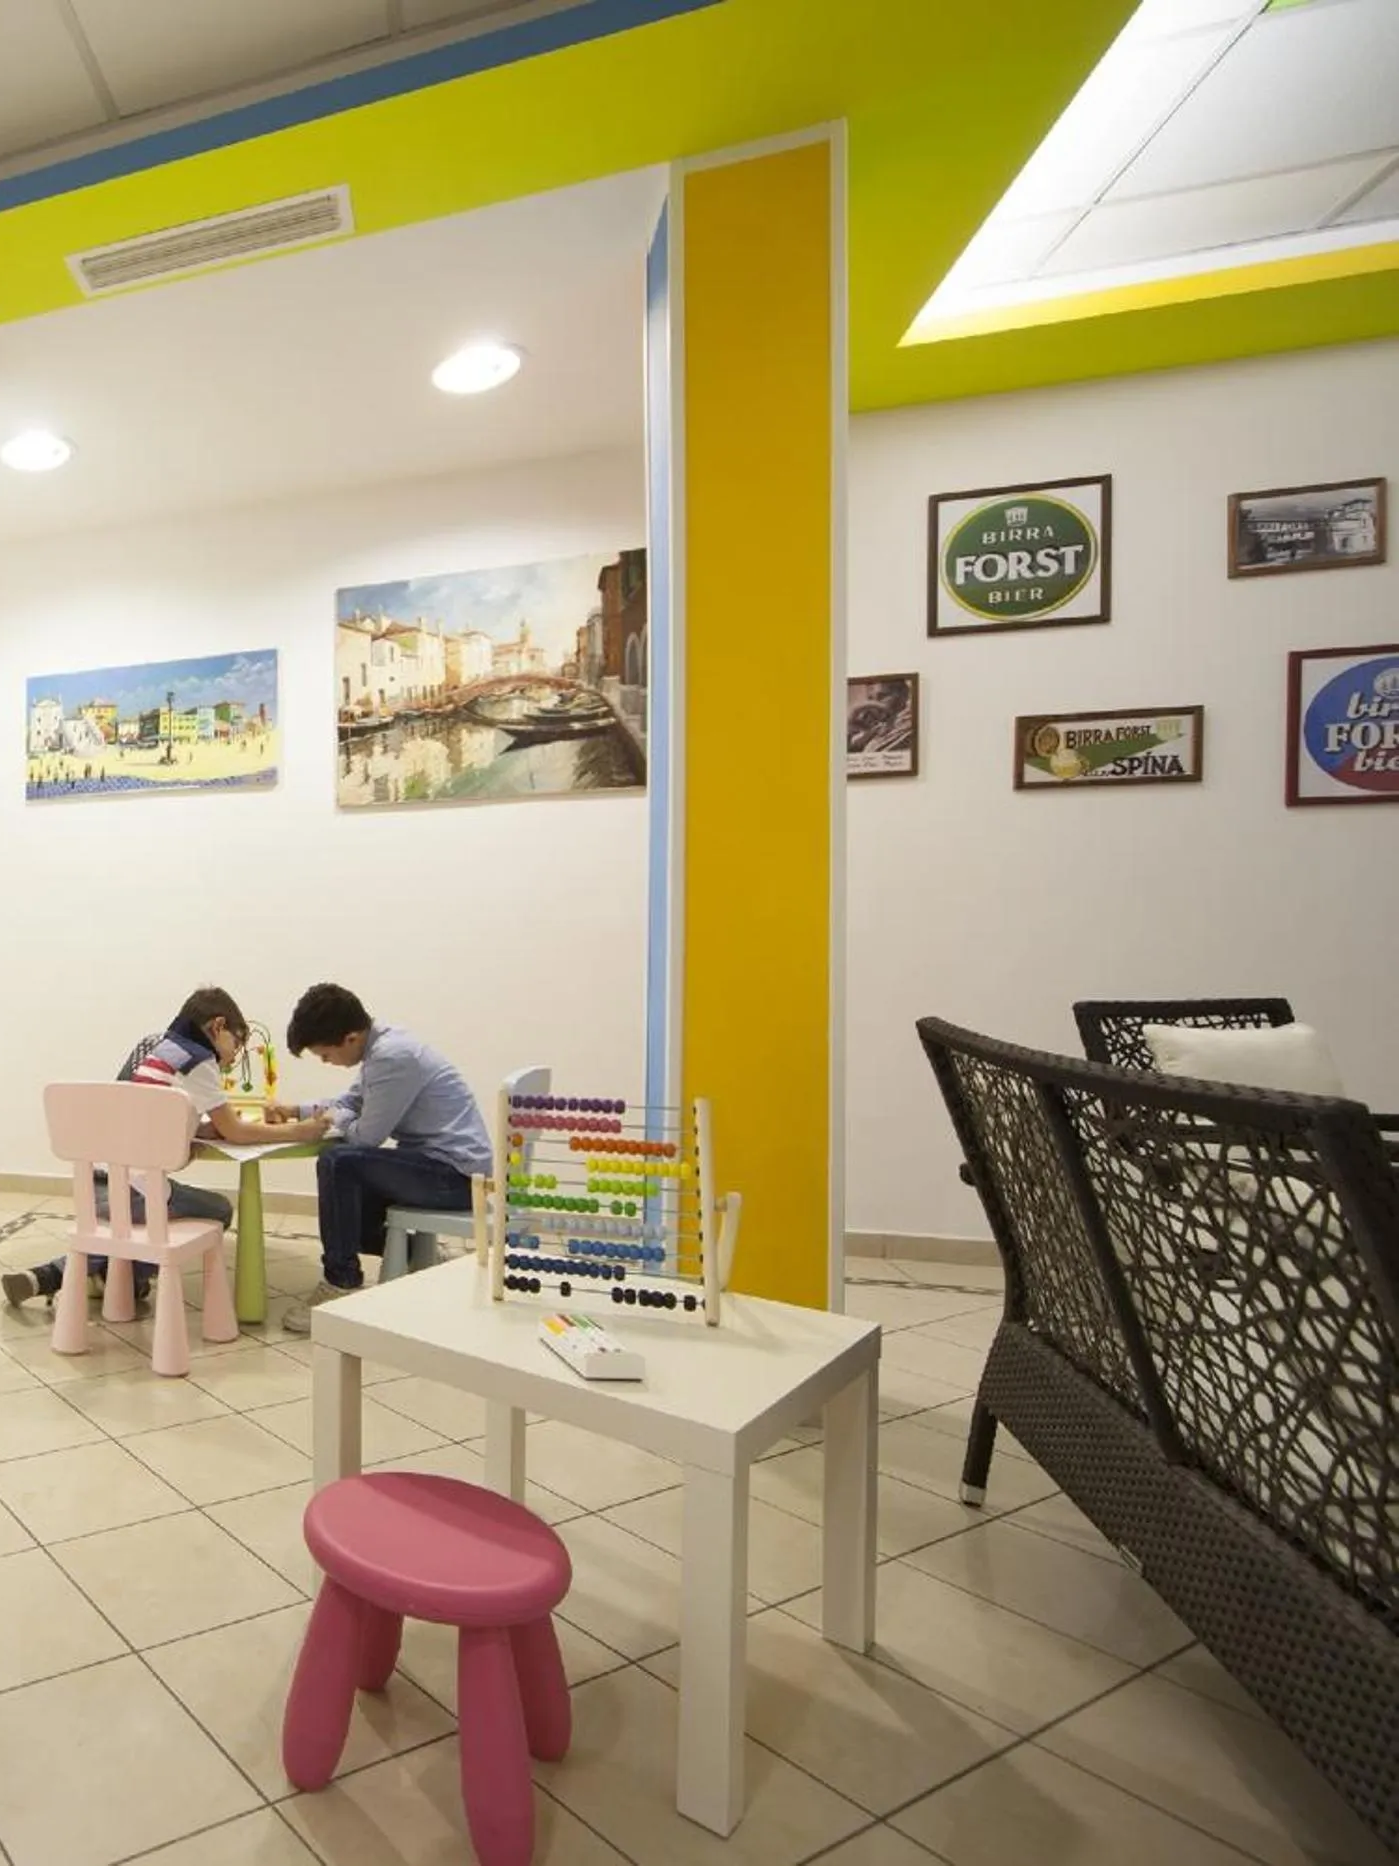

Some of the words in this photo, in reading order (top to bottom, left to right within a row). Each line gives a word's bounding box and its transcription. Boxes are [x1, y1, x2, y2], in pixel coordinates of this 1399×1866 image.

[982, 525, 1054, 544] BIRRA
[955, 544, 1085, 585] FORST
[988, 588, 1045, 604] BIER
[1064, 728, 1113, 749] BIRRA
[1116, 725, 1152, 742] FORST
